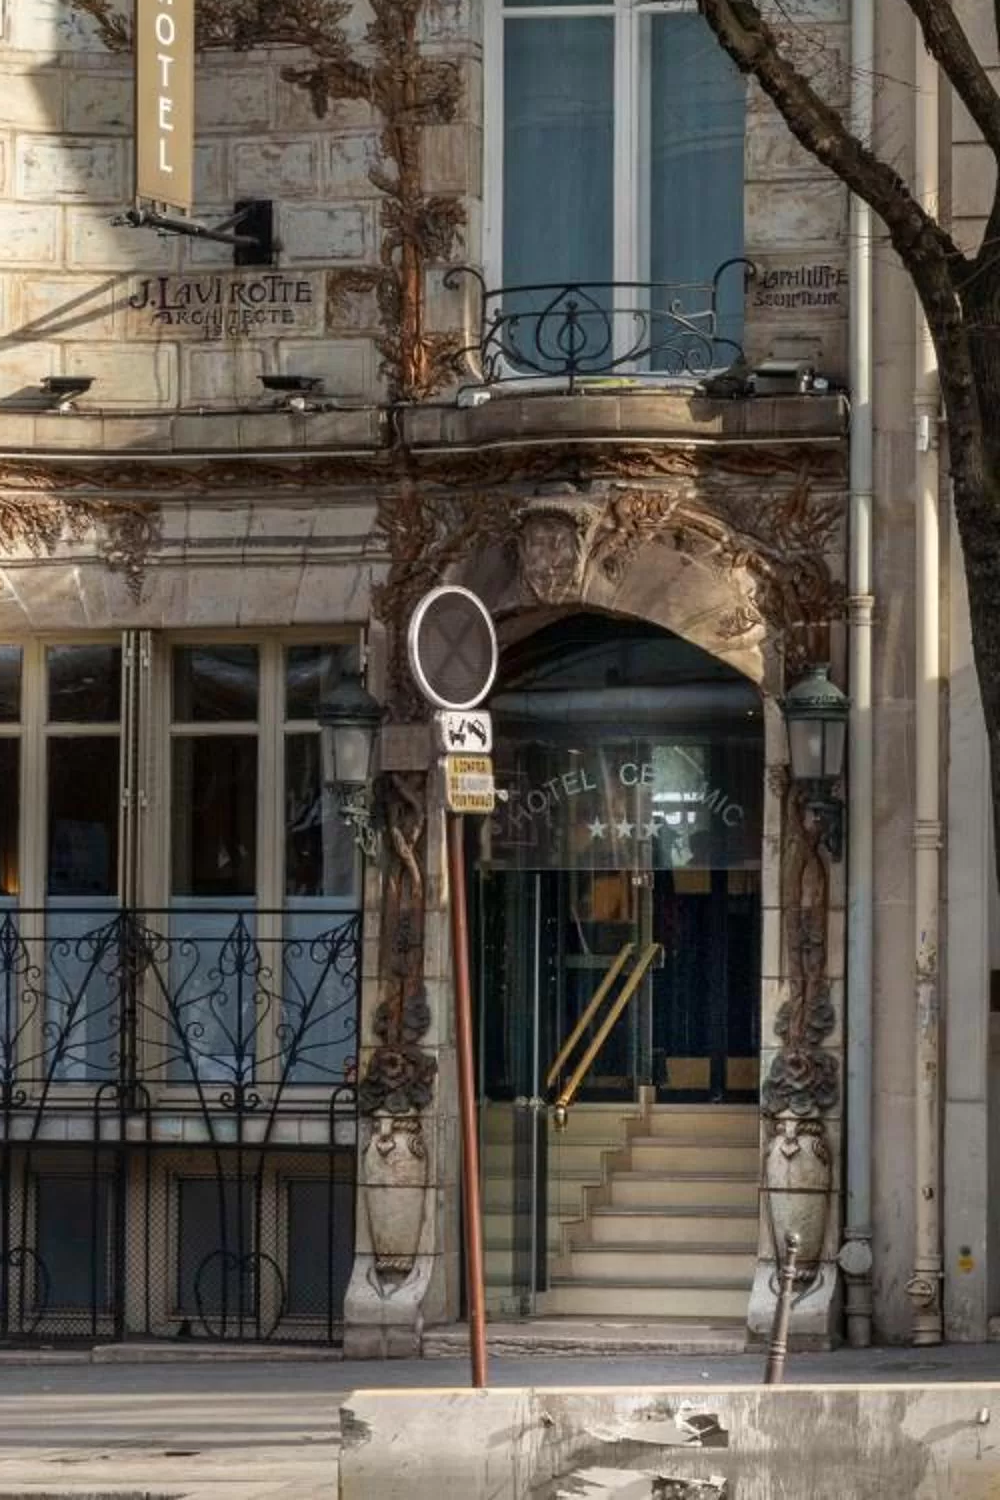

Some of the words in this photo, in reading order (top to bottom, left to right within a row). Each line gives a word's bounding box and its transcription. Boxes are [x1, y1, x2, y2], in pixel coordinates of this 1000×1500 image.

[150, 308, 297, 326] ARCHITECTE
[508, 767, 597, 830] HOTEL
[618, 762, 745, 828] CEMIC
